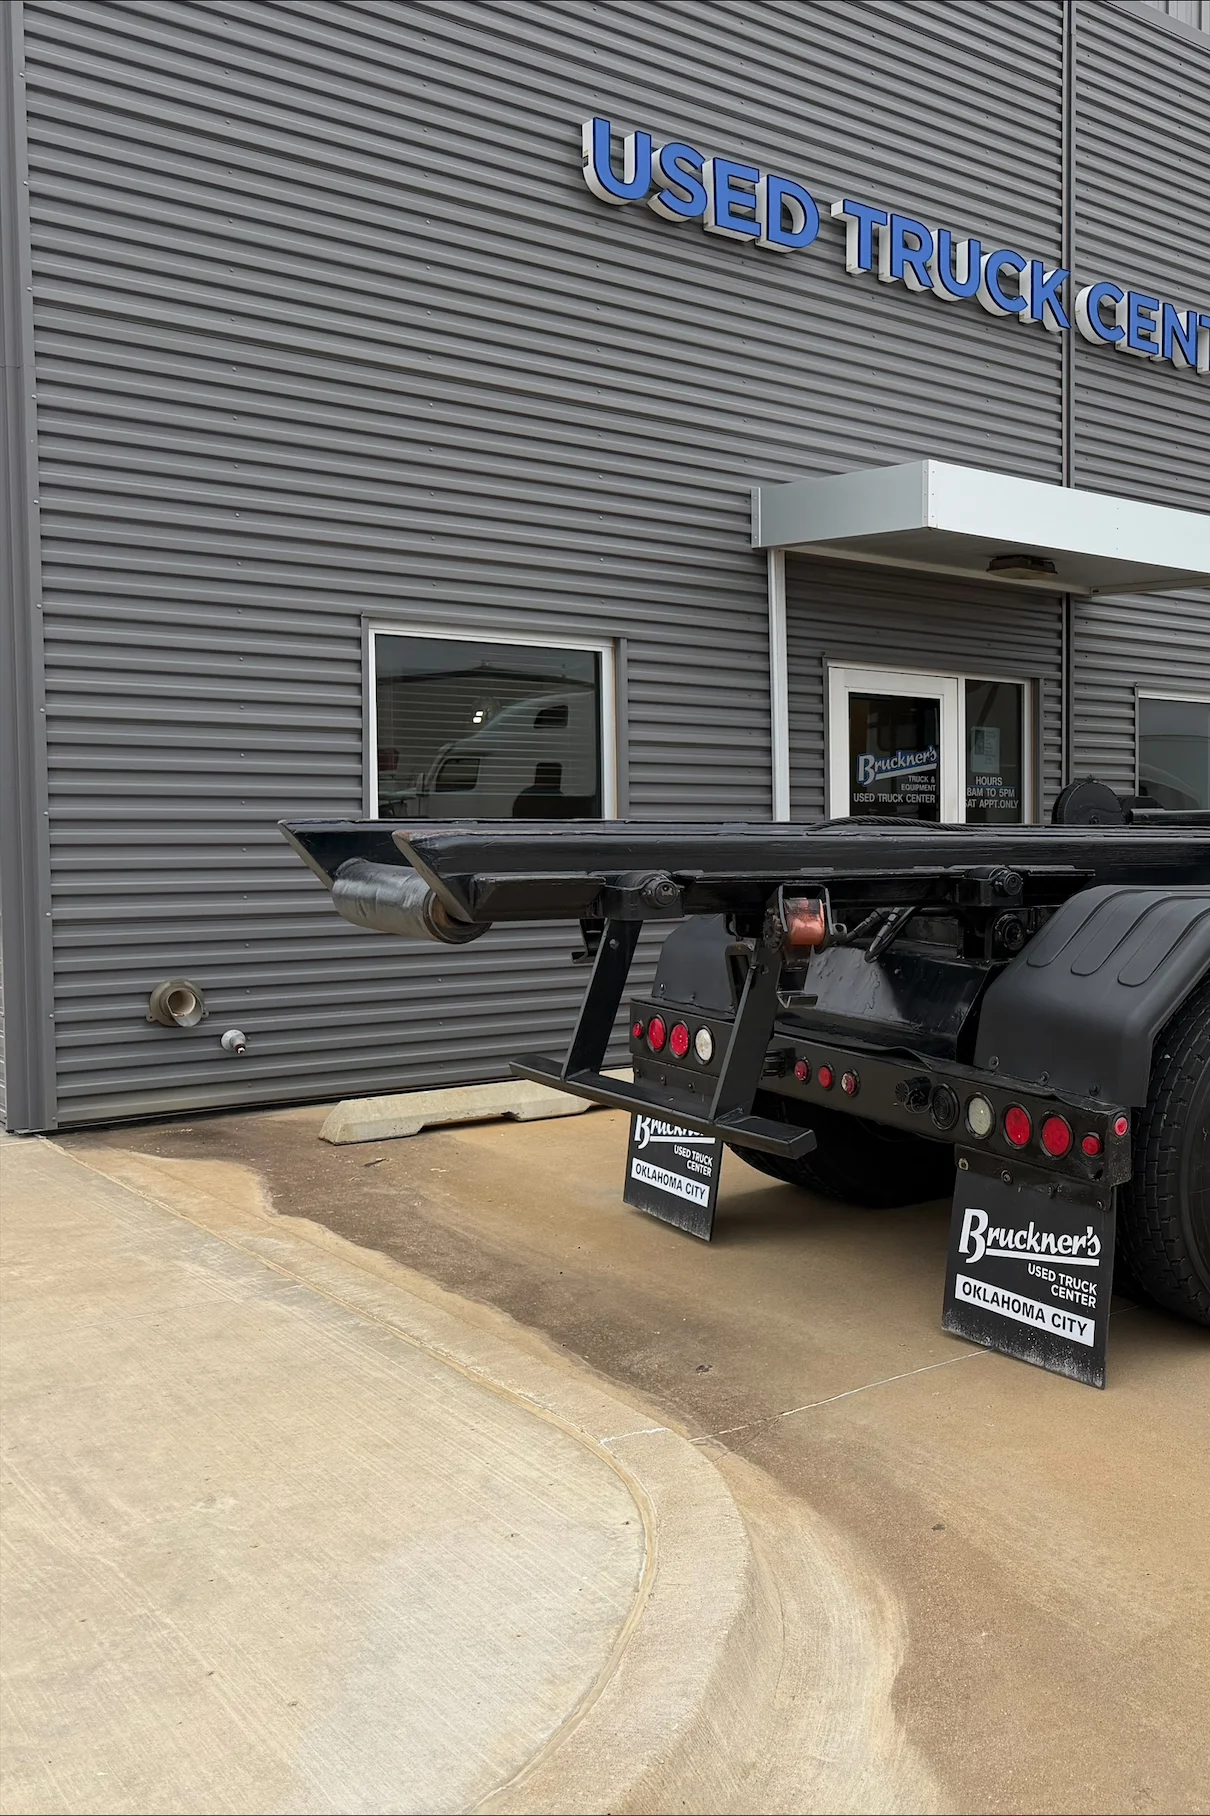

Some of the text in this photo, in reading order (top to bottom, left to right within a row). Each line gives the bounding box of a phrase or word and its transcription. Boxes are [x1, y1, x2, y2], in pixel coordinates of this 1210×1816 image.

[582, 116, 820, 252] USED
[831, 199, 1071, 332] TRUCK
[858, 746, 938, 785] Bruckner's
[901, 784, 936, 792] EQUIPMENT
[908, 775, 929, 783] TRUCK
[975, 776, 1003, 786] HOURS
[853, 793, 936, 803] USED TRUCK CENTER
[966, 787, 1015, 798] 8AM TO 5PM
[674, 1144, 713, 1167] USED TRUCK
[686, 1160, 712, 1177] CENTER
[635, 1163, 706, 1200] OKLAHOMA CITY
[958, 1208, 1101, 1264] Bruckner's
[1028, 1262, 1097, 1296] USED TRUCK
[1051, 1284, 1096, 1309] CENTER
[962, 1281, 1088, 1337] OKLAHOMA CITY
